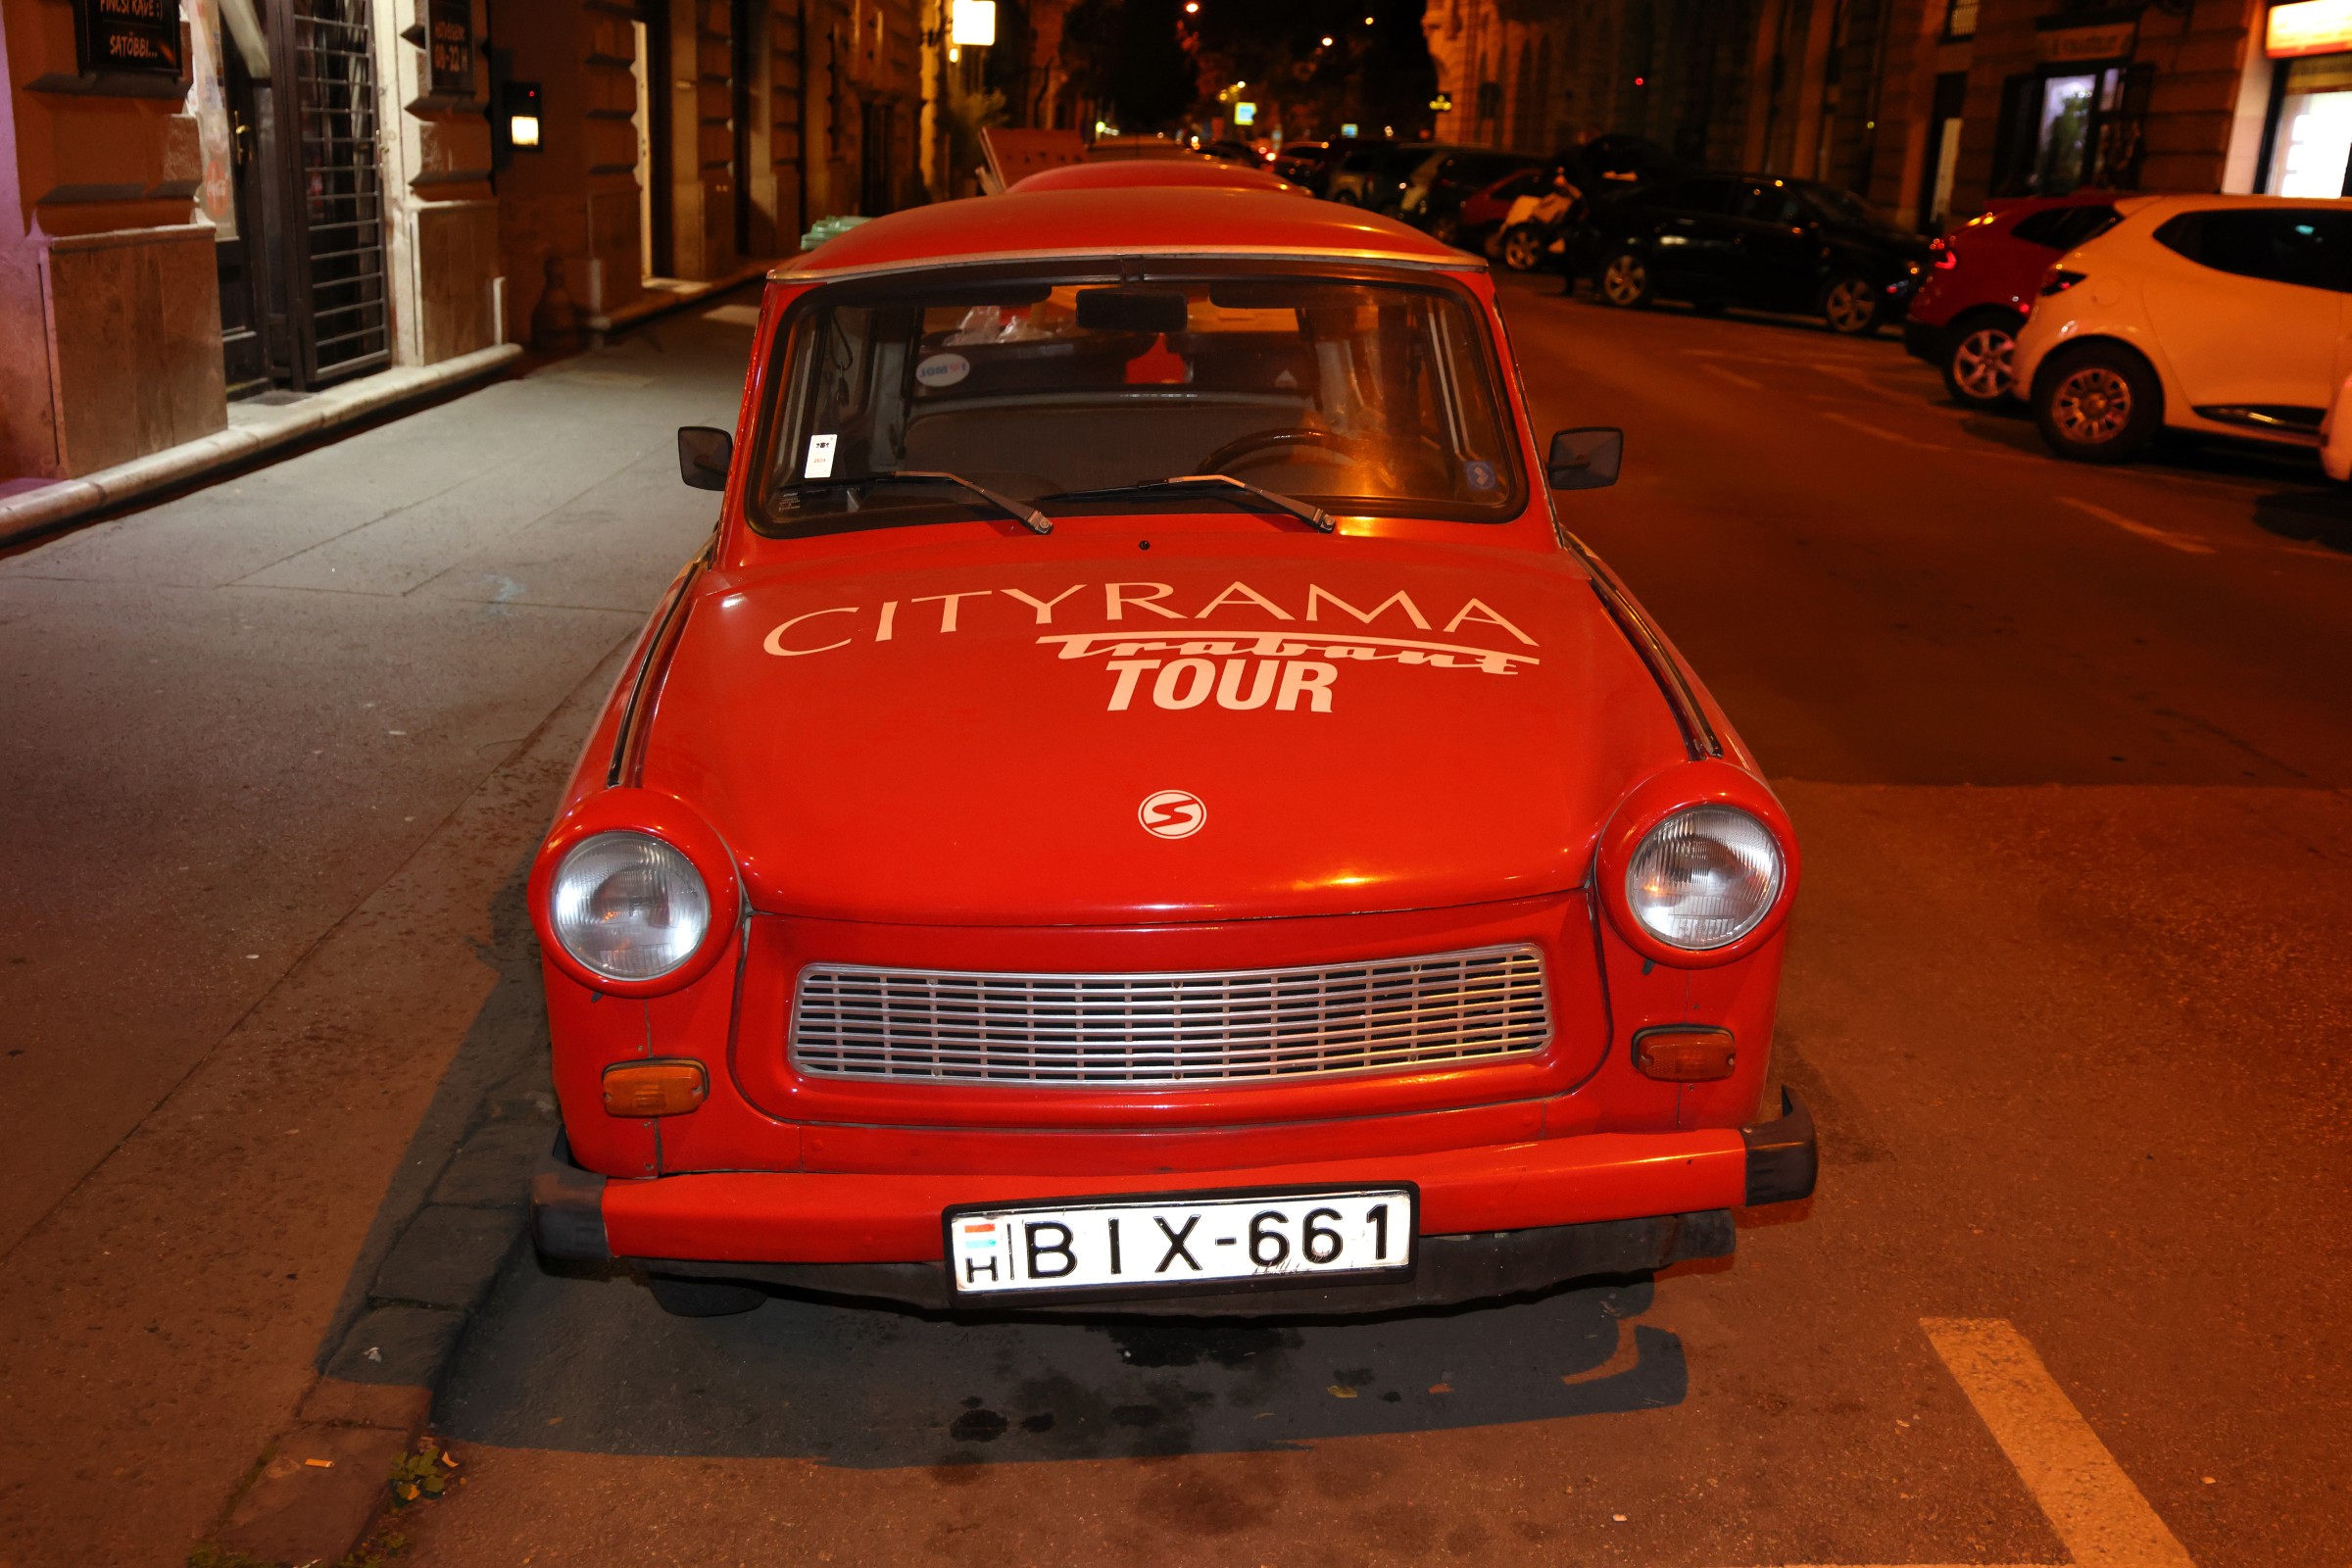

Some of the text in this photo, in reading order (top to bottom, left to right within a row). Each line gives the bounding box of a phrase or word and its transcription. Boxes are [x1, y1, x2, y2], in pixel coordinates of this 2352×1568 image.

[763, 582, 1541, 657] CITYRAMA
[1106, 659, 1339, 712] TOUR
[965, 1204, 1390, 1283] H BIX-661
